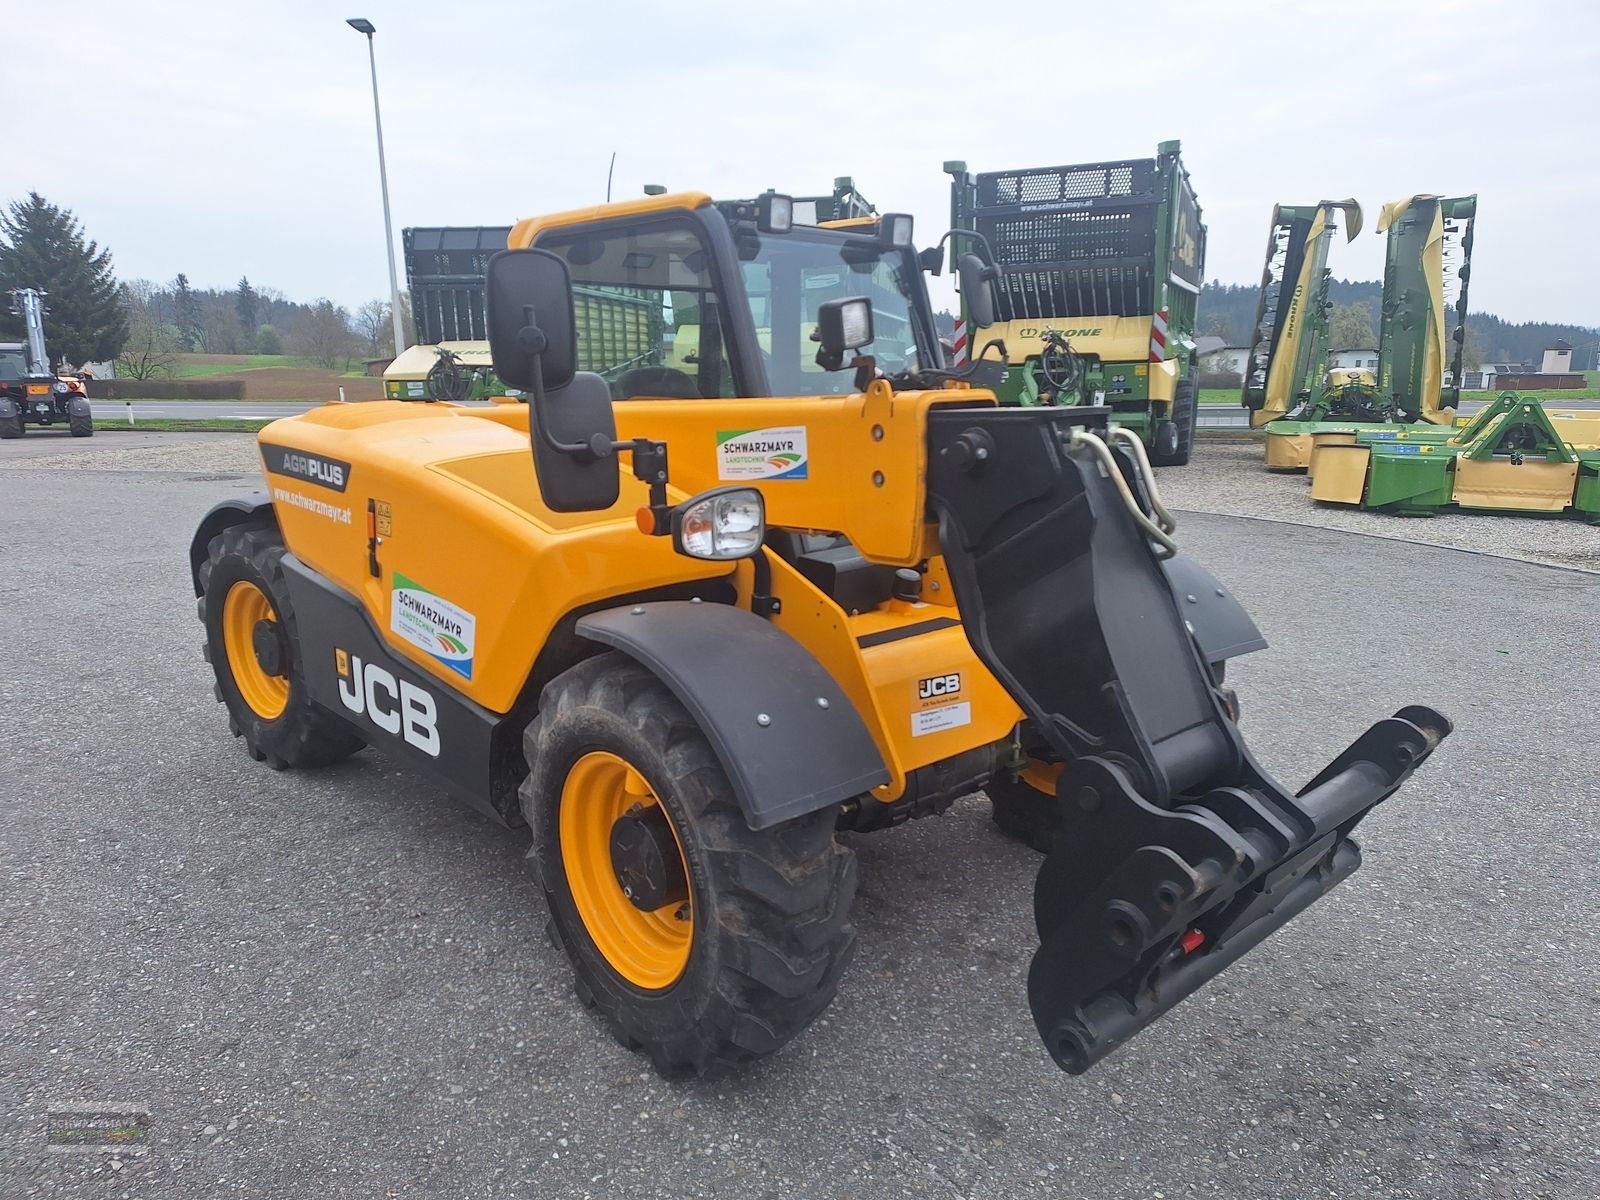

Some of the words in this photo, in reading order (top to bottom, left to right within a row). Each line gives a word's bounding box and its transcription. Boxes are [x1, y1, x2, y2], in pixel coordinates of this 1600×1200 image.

[1021, 200, 1092, 211] www.schwarzmayr.at
[1287, 299, 1298, 339] KRONE
[723, 441, 794, 454] SCHWARZMAYR
[273, 487, 352, 525] www.schwarzmayr.at
[398, 591, 462, 639] SCHWARZMAYR
[920, 675, 960, 698] JCB
[338, 655, 441, 757] JCB
